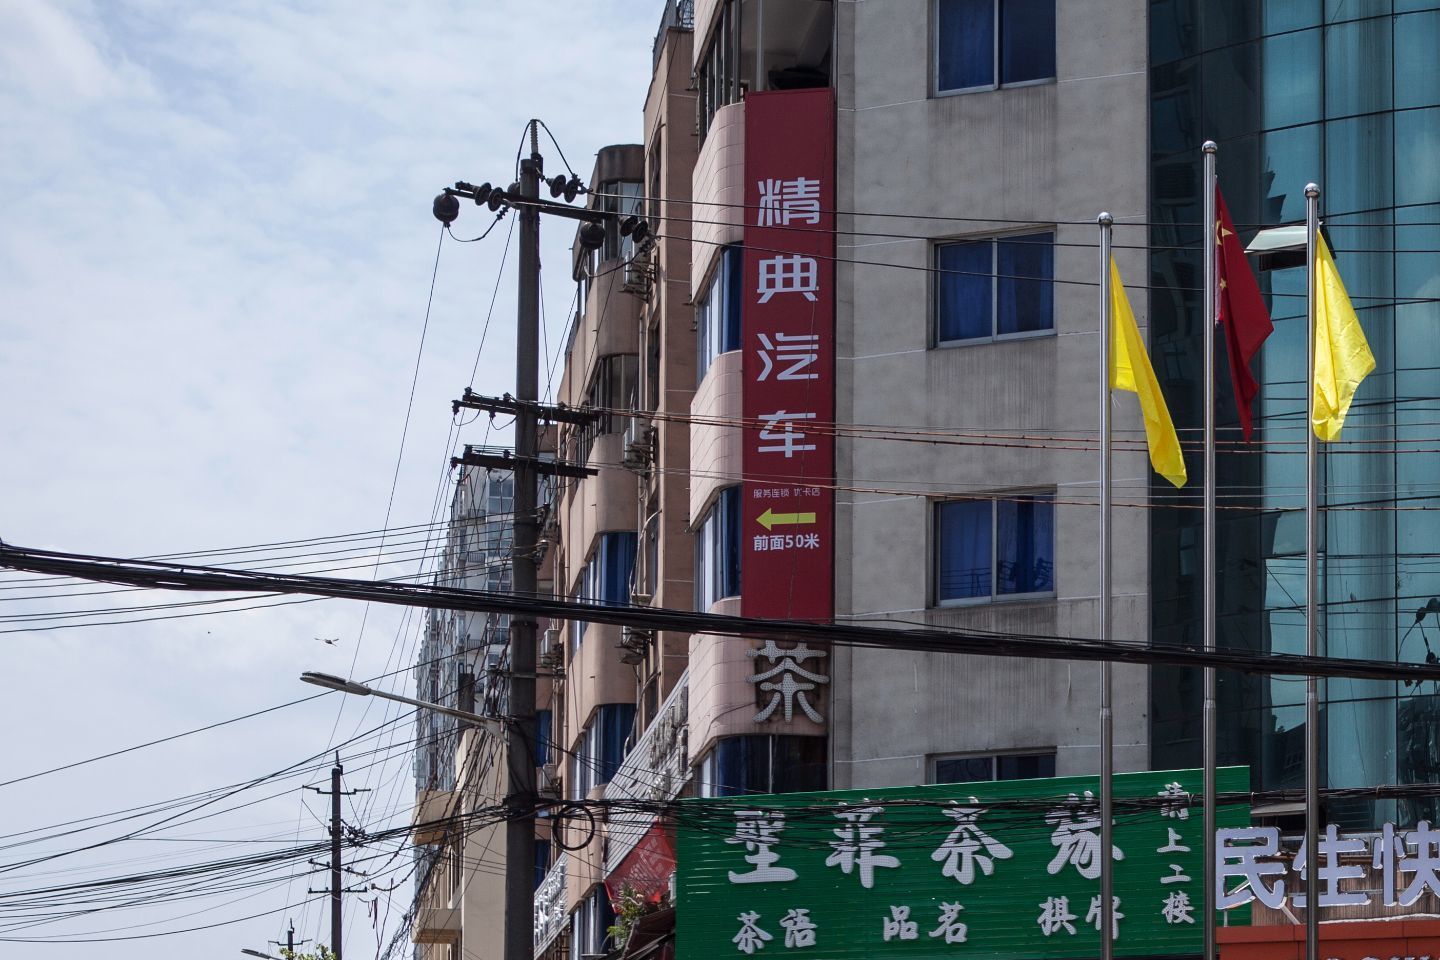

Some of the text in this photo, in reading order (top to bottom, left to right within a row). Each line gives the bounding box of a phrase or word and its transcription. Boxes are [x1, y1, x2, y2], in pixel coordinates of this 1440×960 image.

[756, 176, 820, 458] 精典汽车
[753, 533, 820, 551] 前面50米
[745, 640, 830, 723] 茶
